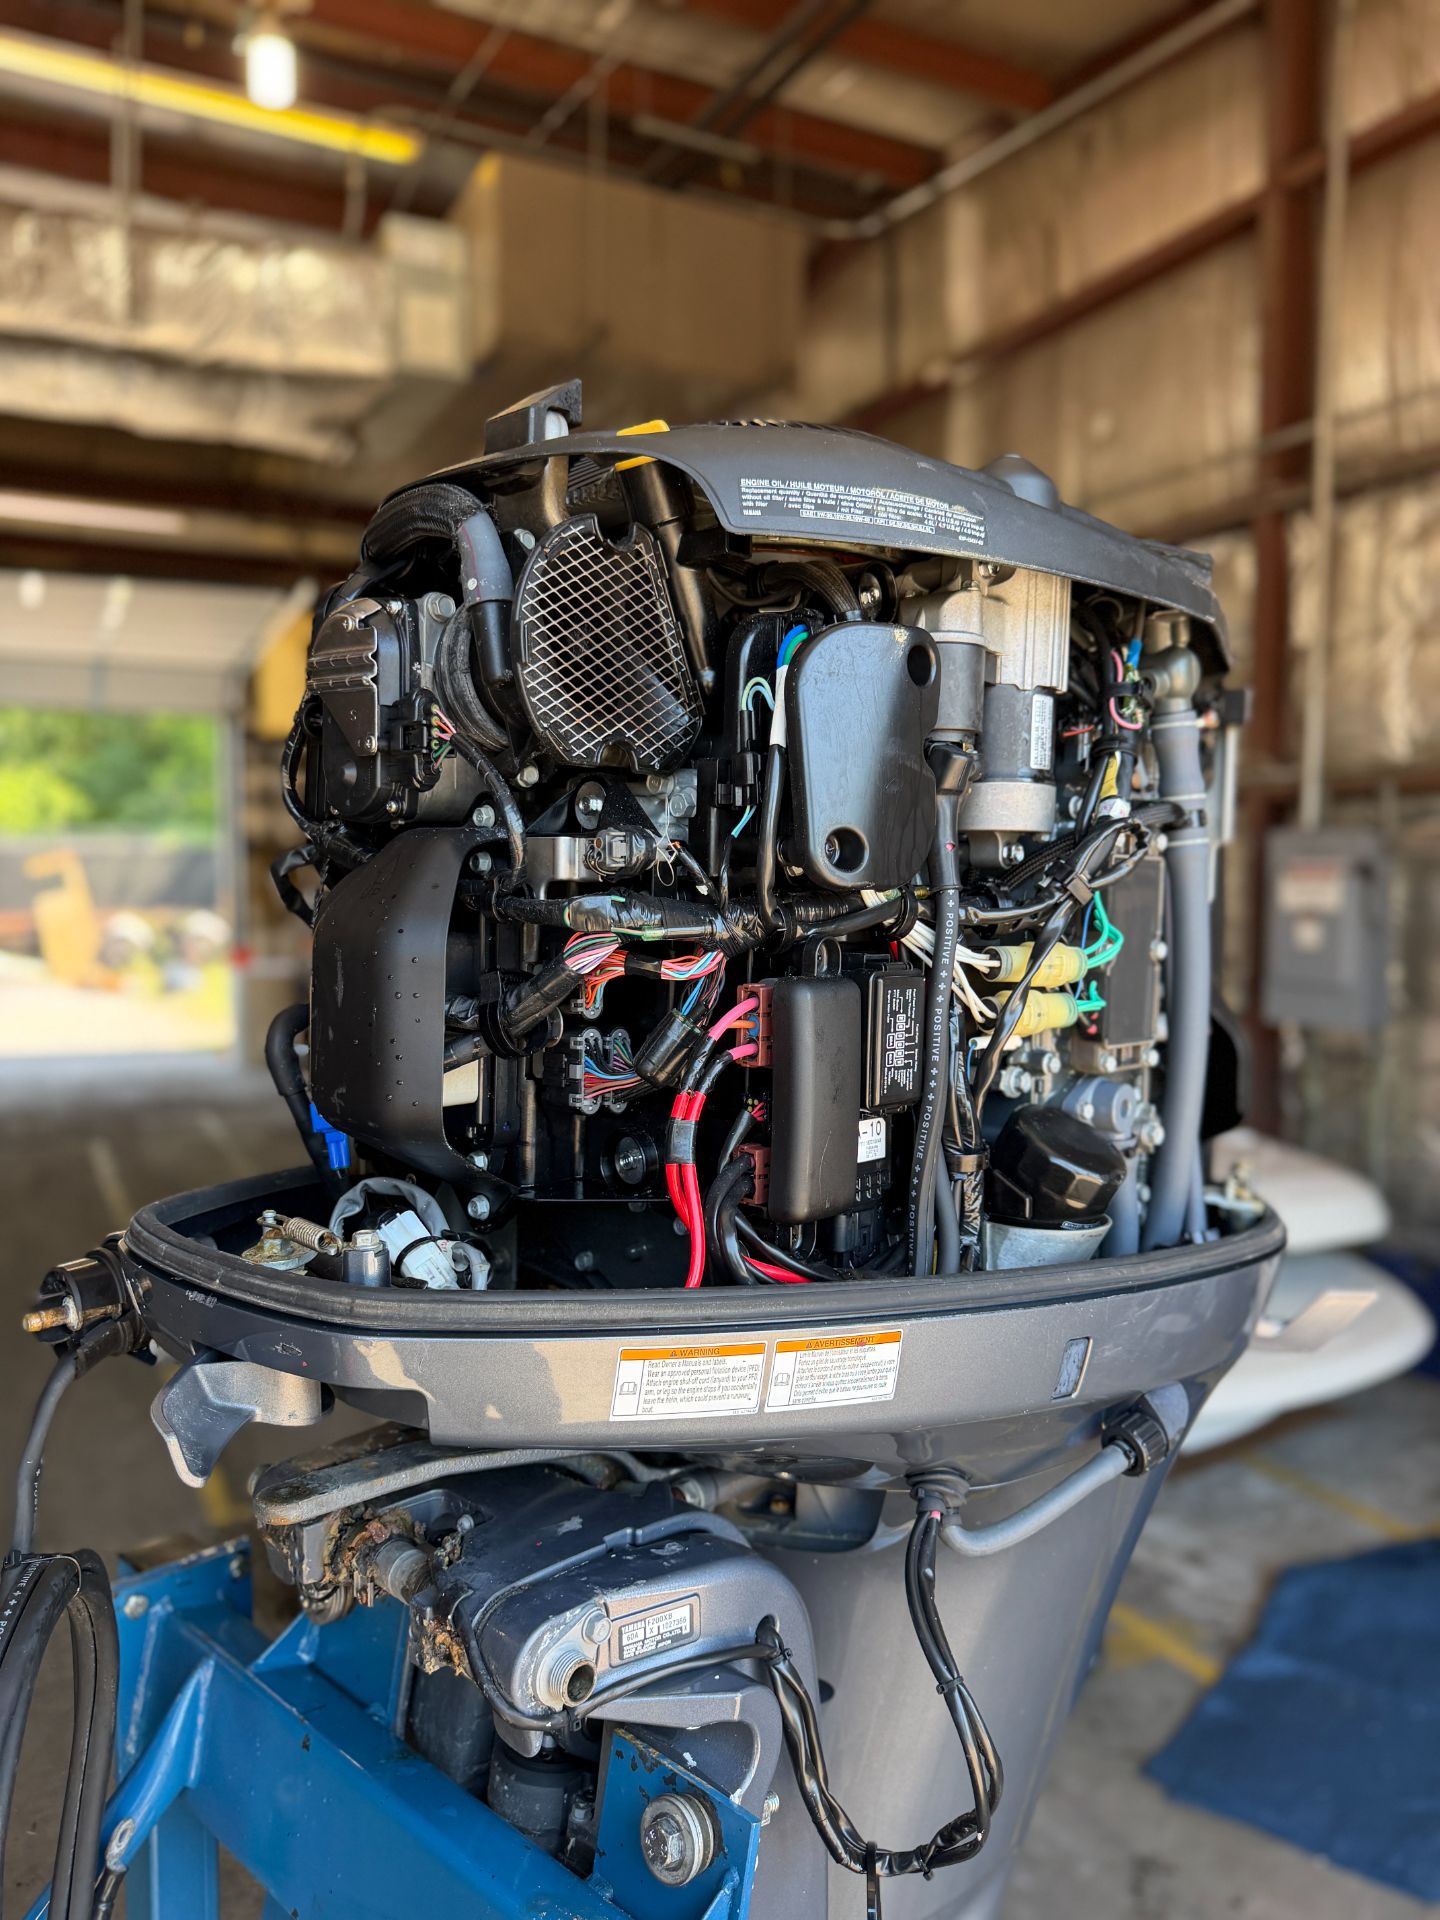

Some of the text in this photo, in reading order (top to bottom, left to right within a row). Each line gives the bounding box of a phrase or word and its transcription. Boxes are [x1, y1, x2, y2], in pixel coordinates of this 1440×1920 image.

[740, 478, 770, 487] ENGINE
[771, 479, 784, 488] OIL
[790, 481, 812, 490] HUILE
[814, 482, 845, 493] MOTEUR
[925, 499, 949, 510] MOTOR
[941, 912, 954, 965] POSITIVE
[931, 1008, 943, 1063] POSITIVE
[917, 1105, 933, 1160] POSITIVE
[908, 1204, 916, 1257] POSITIVE
[680, 1347, 720, 1357] WARNING
[647, 1369, 660, 1378] Wear
[648, 1360, 661, 1369] Read
[645, 1378, 662, 1387] Attach
[662, 1380, 679, 1388] engine
[621, 1612, 673, 1635] YAMAHA F200XB
[649, 1627, 654, 1635] X
